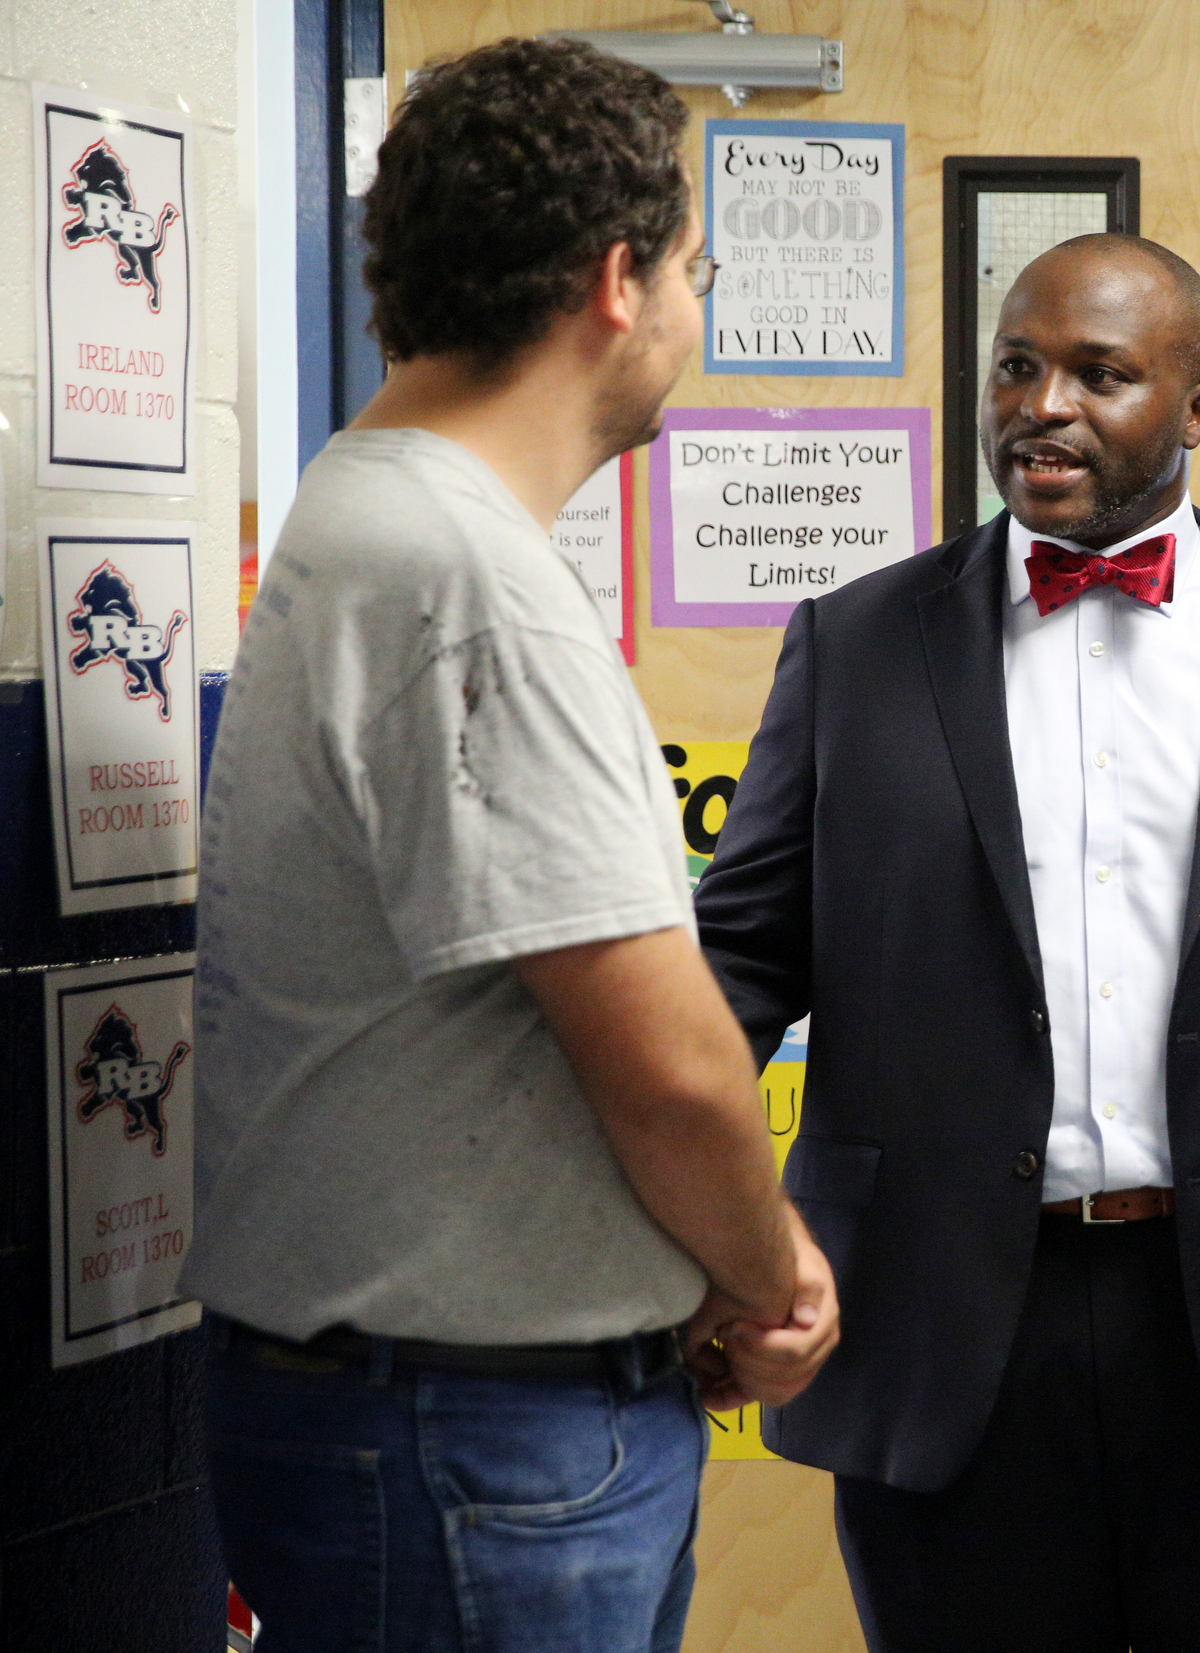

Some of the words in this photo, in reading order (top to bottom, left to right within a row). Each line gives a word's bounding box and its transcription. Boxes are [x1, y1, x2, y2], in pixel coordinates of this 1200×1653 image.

[724, 138, 806, 177] Every
[804, 140, 880, 176] Day
[742, 179, 777, 196] MAY
[788, 180, 825, 197] NOT
[835, 180, 861, 196] BE
[84, 191, 157, 248] RB
[722, 197, 883, 241] GOOD
[730, 245, 769, 263] BUT
[777, 246, 843, 263] THERE
[852, 247, 874, 263] IS
[718, 266, 891, 301] SOMETHING
[750, 305, 809, 326] GOOD
[821, 306, 848, 325] IN
[717, 327, 814, 356] EVERY
[822, 329, 885, 356] DAY.
[77, 343, 165, 378] IRELAND
[64, 383, 128, 416] ROOM
[135, 391, 175, 421] 1370
[681, 442, 755, 467] Don't
[762, 442, 832, 467] Limit
[838, 442, 903, 468] Your
[722, 481, 863, 506] Challenges
[555, 505, 611, 521] ourself
[559, 532, 572, 546] is
[575, 535, 604, 547] our
[695, 523, 824, 548] Challenge
[831, 526, 889, 548] your
[748, 562, 836, 588] Limits!
[90, 614, 165, 660] RB
[89, 759, 180, 792] RUSSELL
[78, 803, 145, 835] ROOM
[152, 798, 190, 828] 1370
[97, 1057, 162, 1100] RB
[80, 1242, 136, 1285] ROOM
[143, 1228, 185, 1264] 1370
